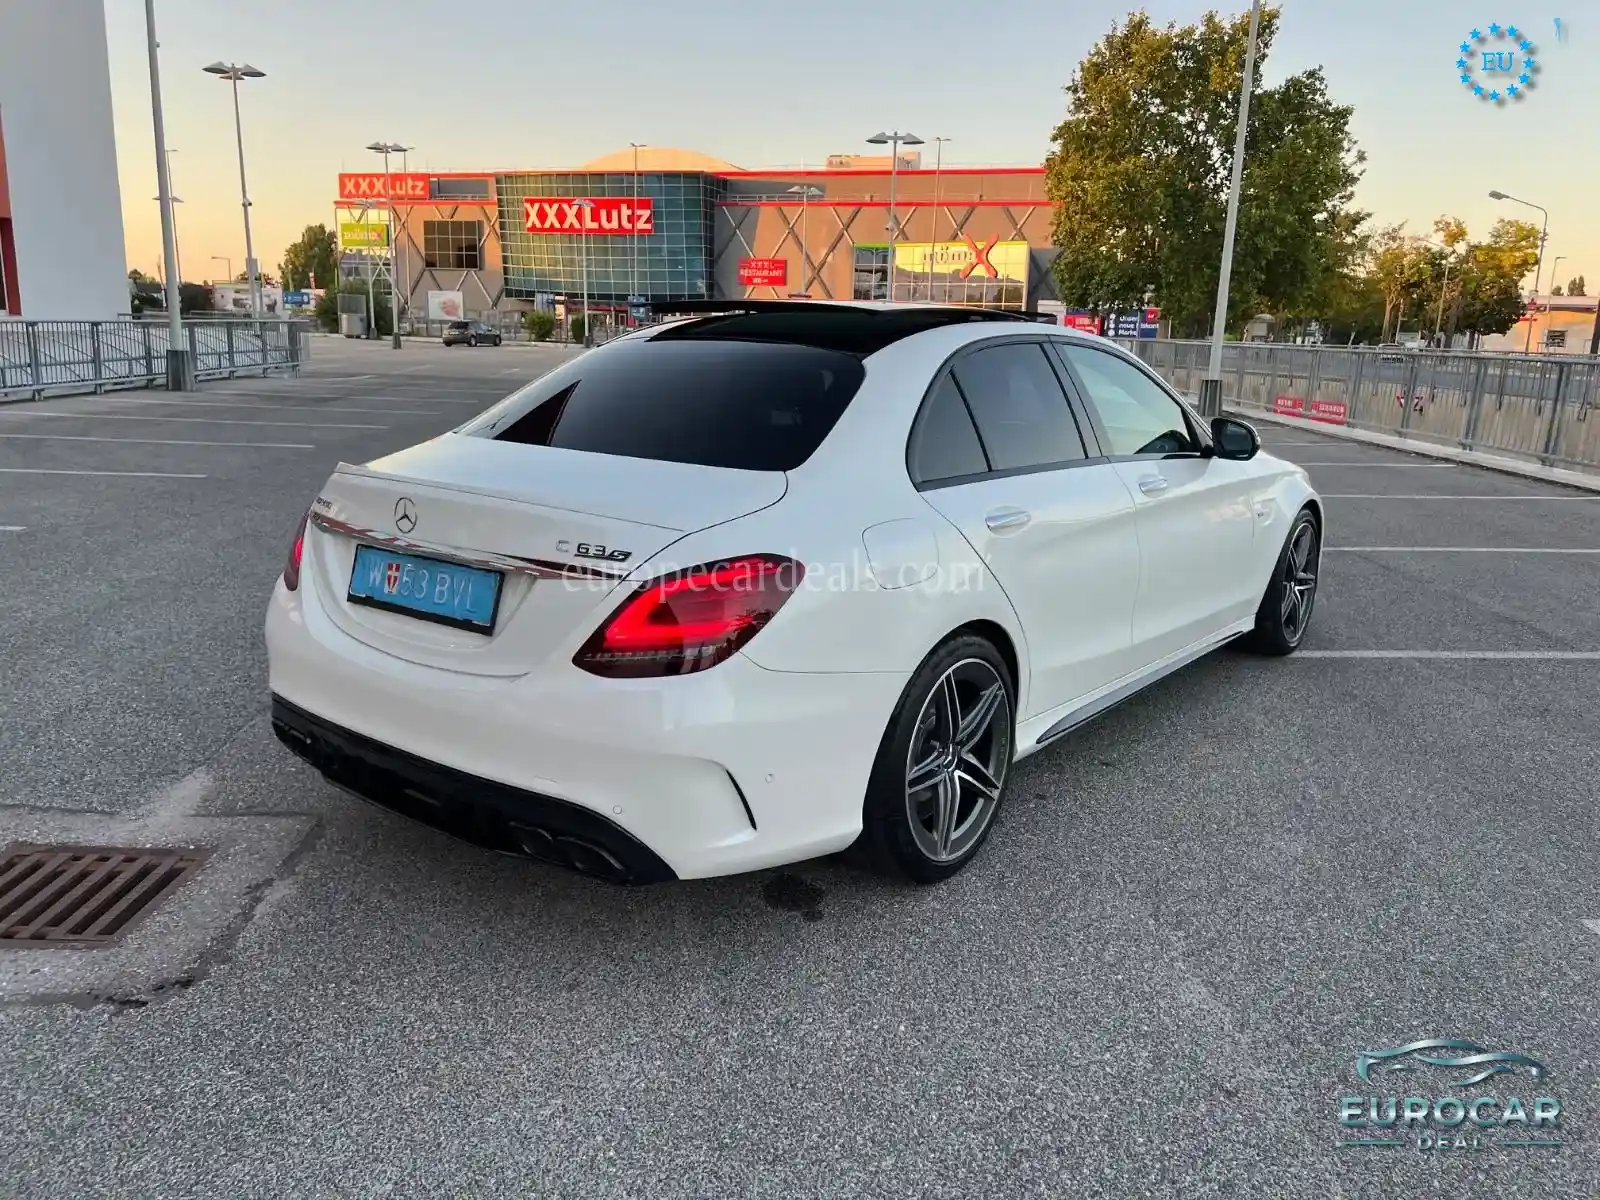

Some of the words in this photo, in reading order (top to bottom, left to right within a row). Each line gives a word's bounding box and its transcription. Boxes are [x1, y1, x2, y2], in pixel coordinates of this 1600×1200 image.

[343, 177, 426, 195] XXXLutz
[525, 203, 652, 230] XXXLutz
[556, 540, 570, 553] C
[368, 557, 384, 588] W
